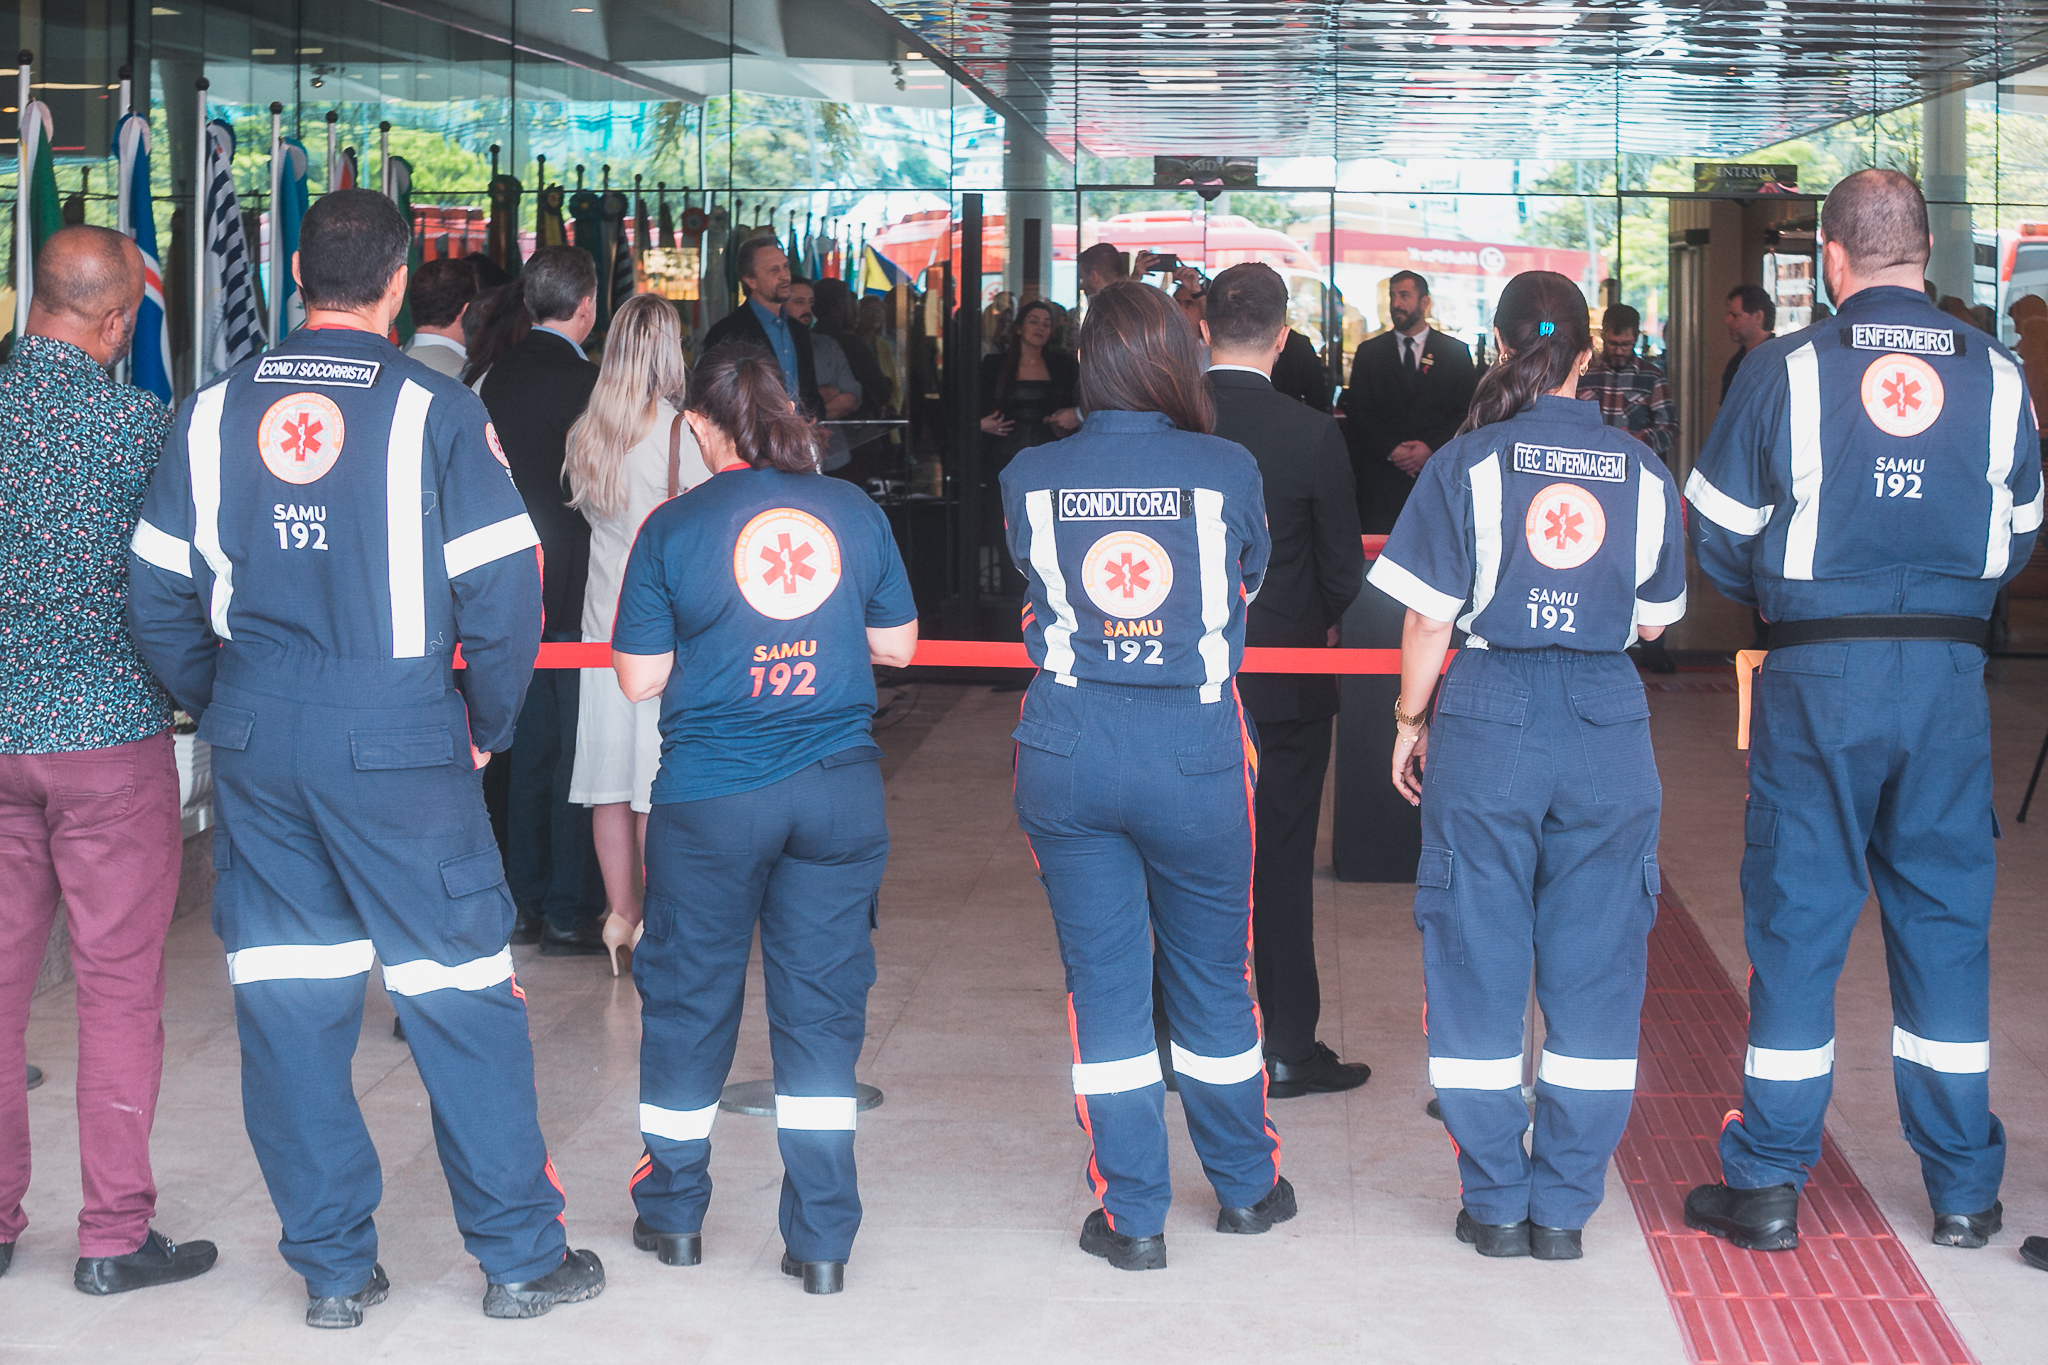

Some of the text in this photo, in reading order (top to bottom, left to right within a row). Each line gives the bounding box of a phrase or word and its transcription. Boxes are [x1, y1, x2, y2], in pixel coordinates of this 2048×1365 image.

[1716, 166, 1777, 179] ENTRADA
[1856, 327, 1950, 352] ENFERMEIRO
[1518, 446, 1622, 478] TÉC ENFERMAGEM
[1874, 457, 1926, 474] SAMU
[1873, 473, 1924, 499] 192
[272, 503, 327, 522] SAMU
[1063, 492, 1177, 517] CONDUTORA
[273, 521, 329, 551] 192
[1528, 587, 1580, 607] SAMU
[1104, 619, 1164, 637] SAMU
[1526, 603, 1577, 634] 192
[753, 640, 817, 663] SAMU
[1102, 639, 1164, 665] 192
[750, 661, 817, 698] 192
